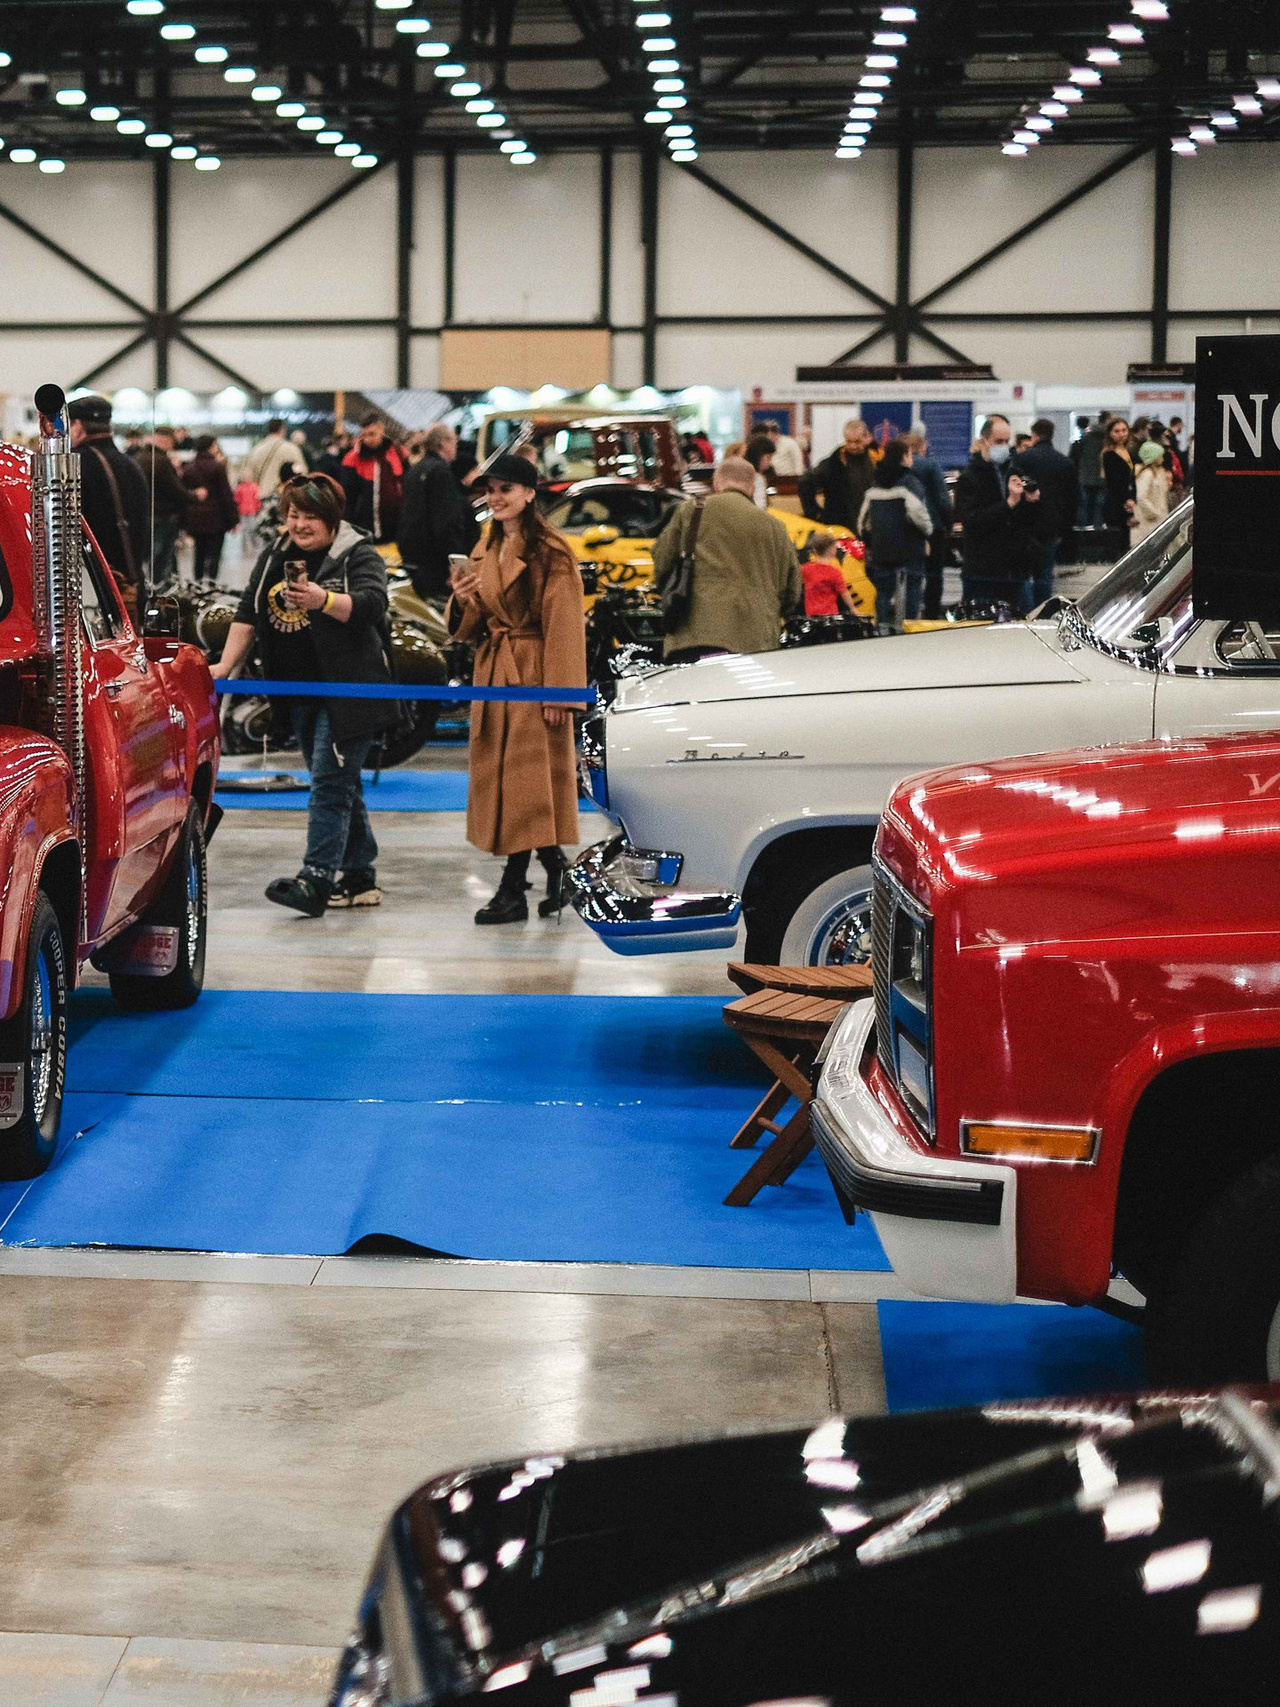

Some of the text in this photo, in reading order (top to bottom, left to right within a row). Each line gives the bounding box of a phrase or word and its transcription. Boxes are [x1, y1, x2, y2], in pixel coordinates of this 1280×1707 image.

[1216, 393, 1280, 458] N
[49, 929, 66, 1100] COOPER COBRA
